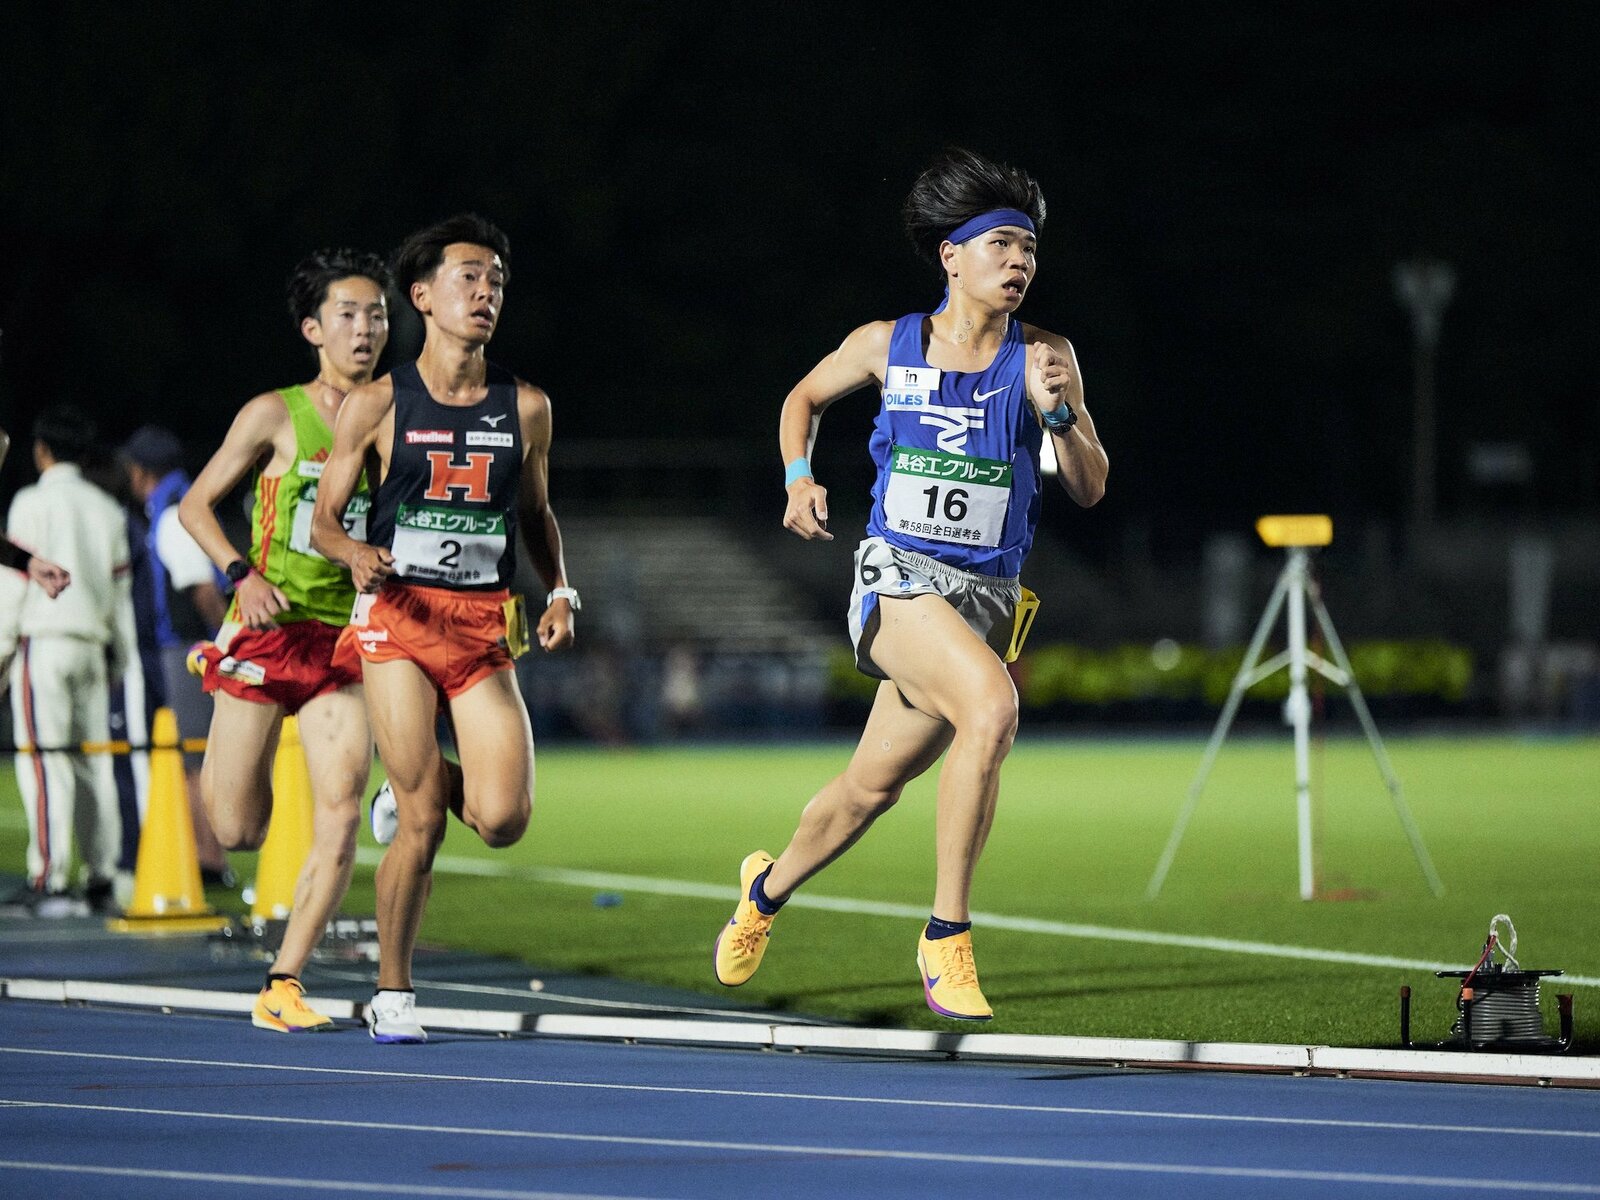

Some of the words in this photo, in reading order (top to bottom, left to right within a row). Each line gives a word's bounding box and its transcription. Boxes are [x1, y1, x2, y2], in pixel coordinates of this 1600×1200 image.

[904, 369, 918, 384] in
[885, 393, 923, 406] OILES
[424, 450, 494, 503] H
[895, 452, 1008, 483] 長谷工グループ
[923, 485, 969, 522] 16
[898, 518, 982, 541] 第58回全日選考会
[438, 539, 462, 569] 2
